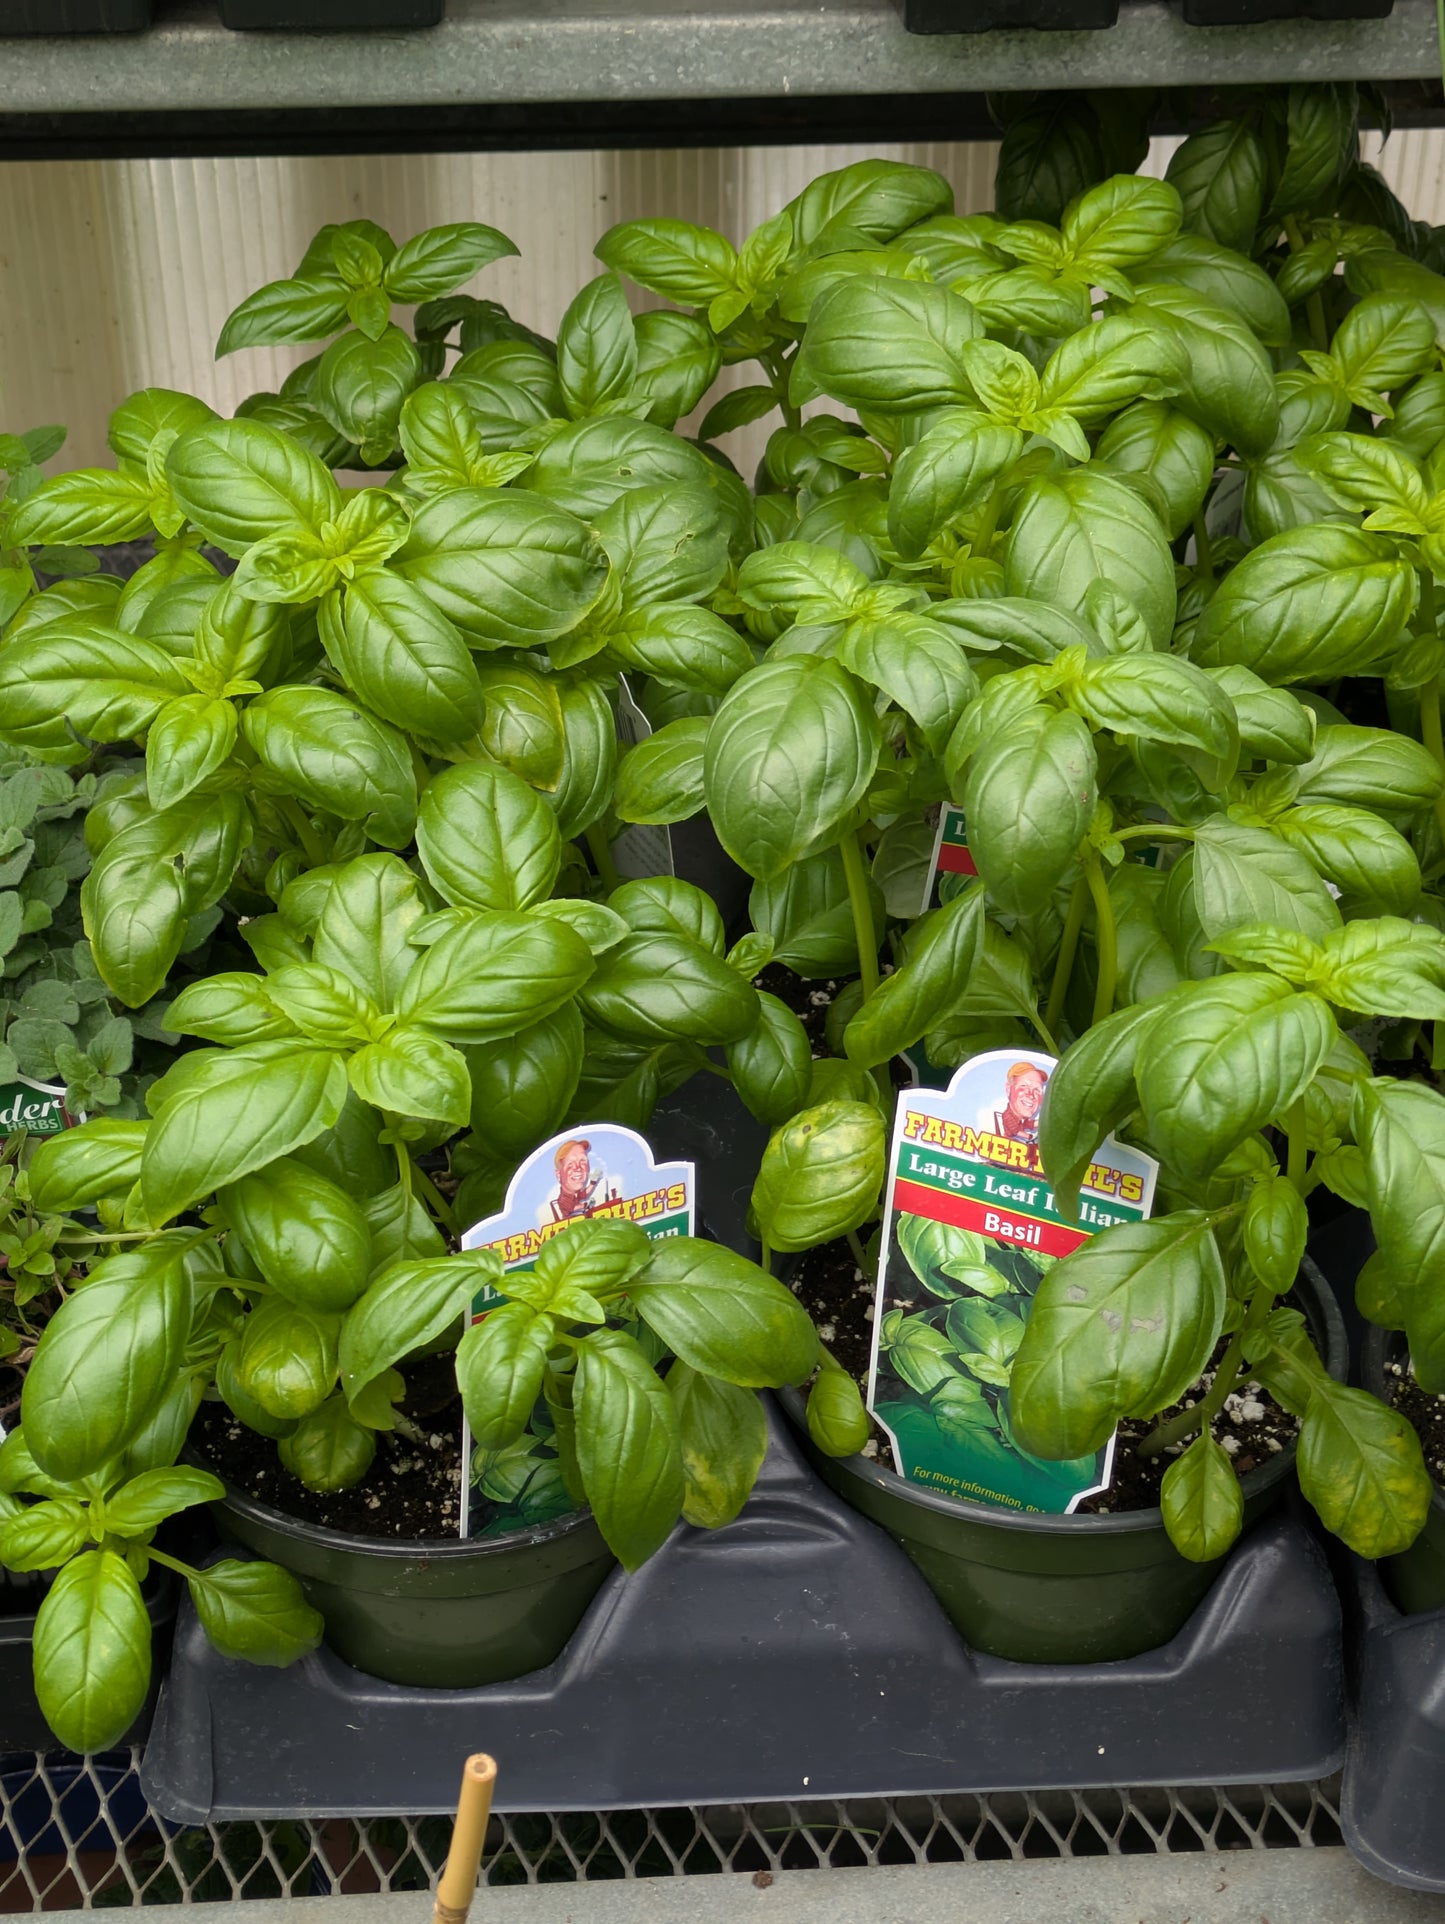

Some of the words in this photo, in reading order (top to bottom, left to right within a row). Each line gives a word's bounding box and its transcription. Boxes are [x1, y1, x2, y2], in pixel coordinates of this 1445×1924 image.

[903, 1110, 1030, 1169] FARMER
[909, 1153, 977, 1189] Large
[983, 1174, 1041, 1206] Leaf
[1043, 1192, 1128, 1228] Ilia
[983, 1212, 1042, 1246] Basil
[913, 1466, 931, 1479] For
[932, 1472, 960, 1487] more
[960, 1479, 1024, 1511] information,
